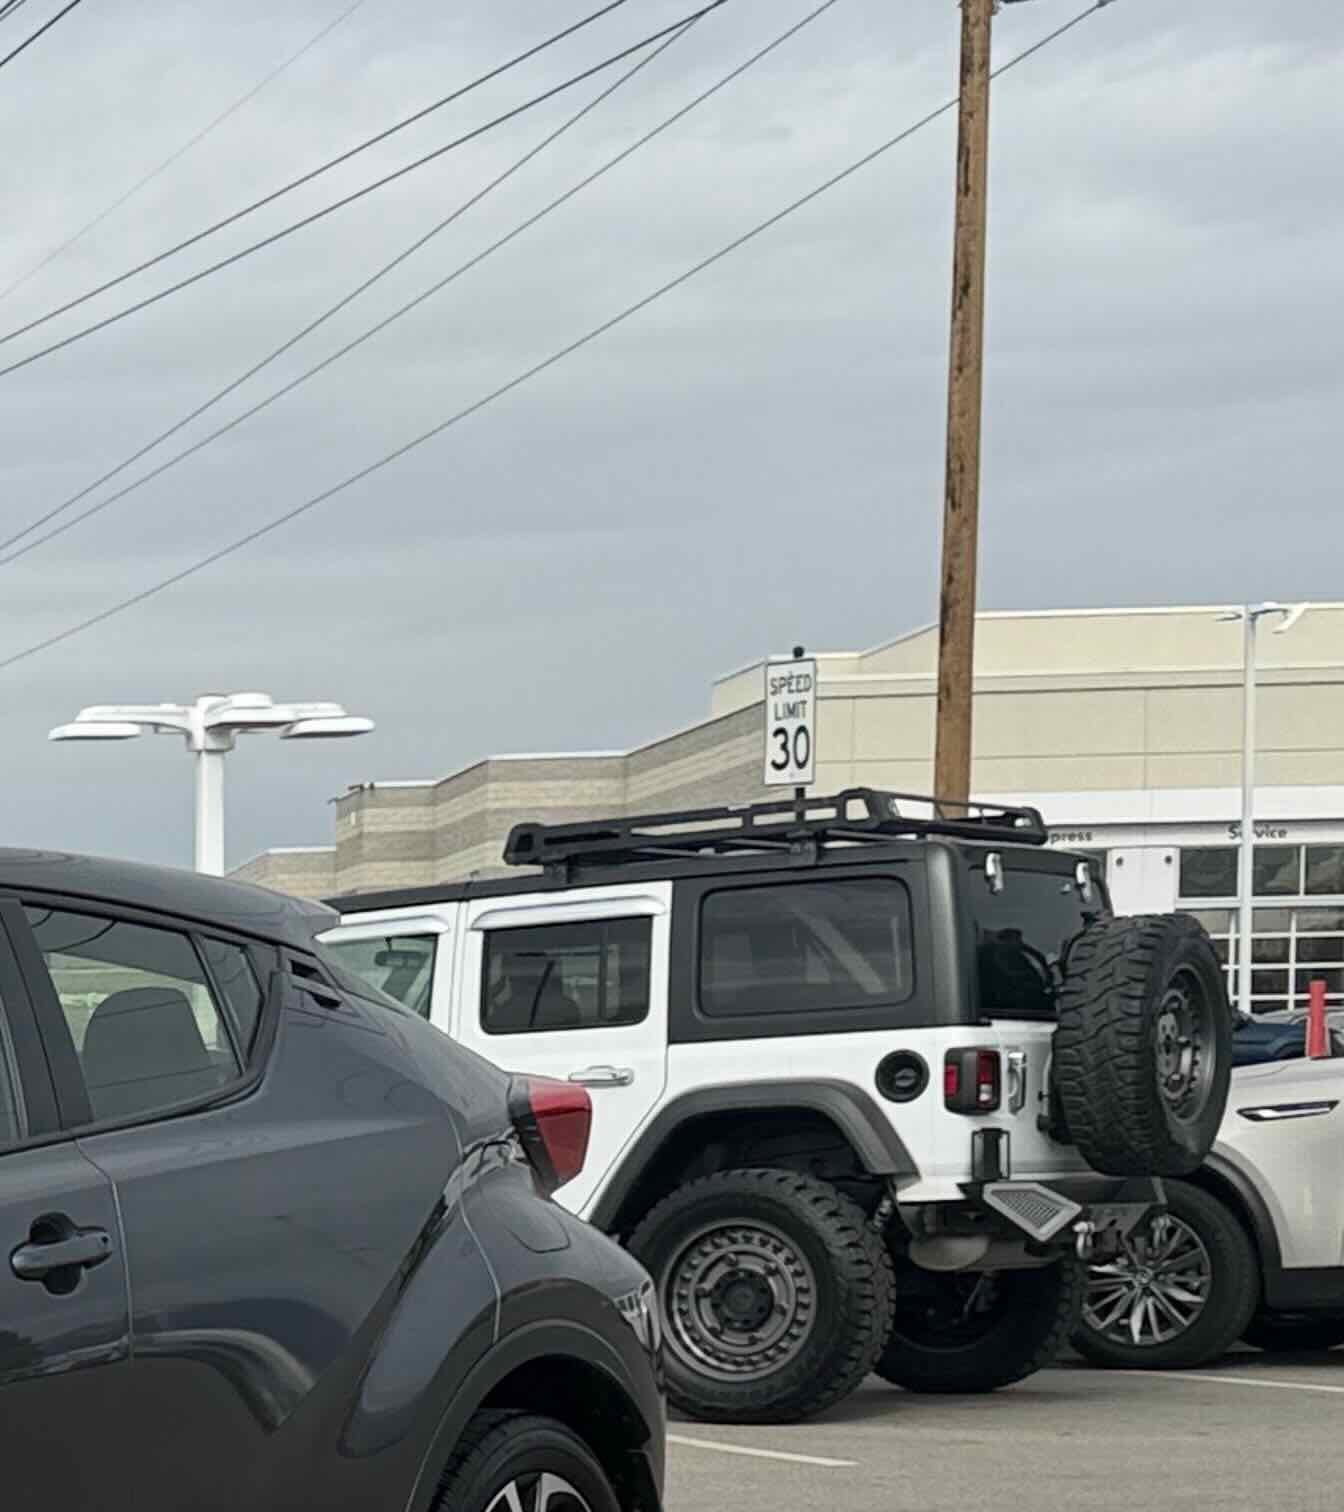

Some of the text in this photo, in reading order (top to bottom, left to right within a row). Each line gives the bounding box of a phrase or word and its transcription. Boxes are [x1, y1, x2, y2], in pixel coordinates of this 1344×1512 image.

[769, 672, 812, 696] SPEED
[773, 700, 808, 721] LIMIT
[770, 724, 811, 771] 30
[1049, 830, 1093, 845] press
[1228, 822, 1289, 840] Svice
